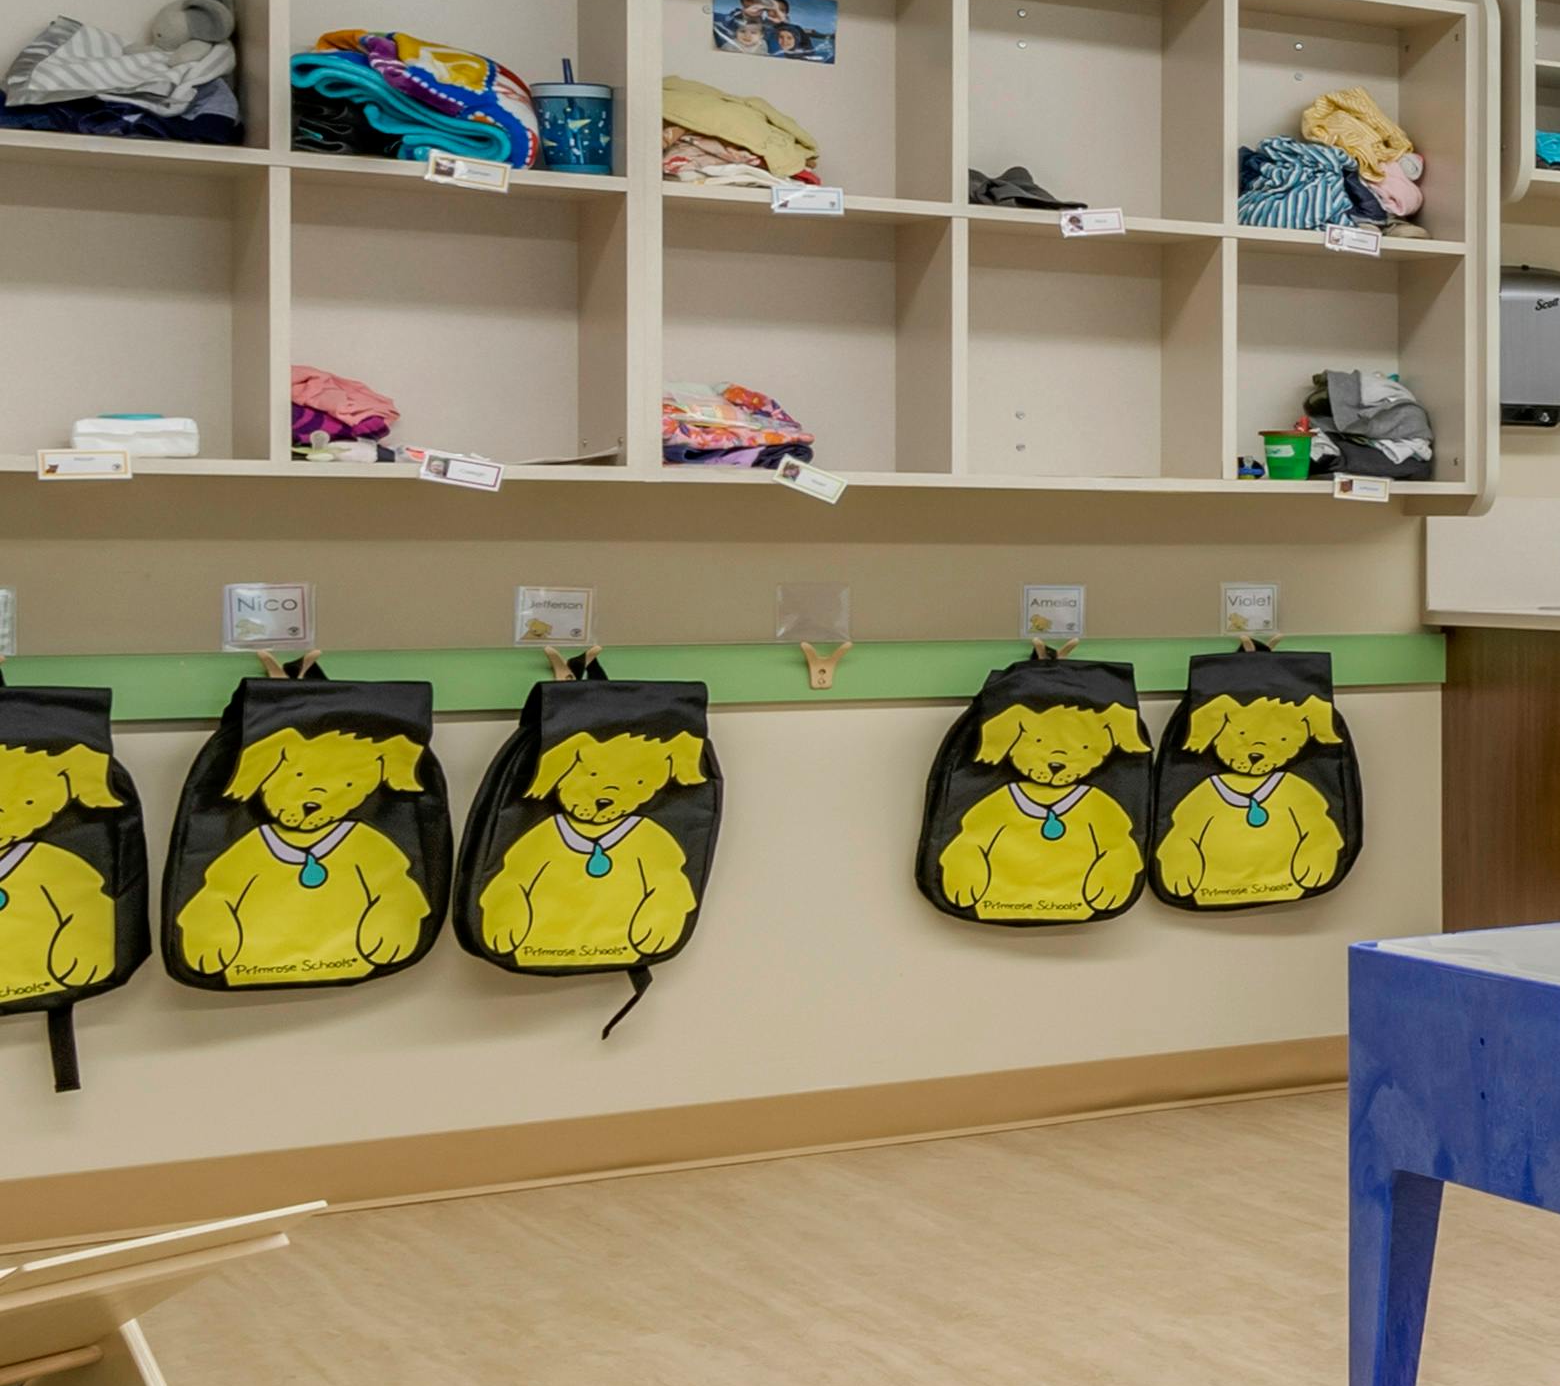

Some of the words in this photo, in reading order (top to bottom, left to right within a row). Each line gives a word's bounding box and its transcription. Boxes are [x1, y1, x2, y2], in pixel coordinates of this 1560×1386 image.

[1535, 298, 1559, 310] Scott
[237, 597, 298, 612] Nico
[529, 598, 583, 610] Jefferson
[1030, 597, 1077, 608] Amelia
[1228, 595, 1272, 607] Violet
[1200, 886, 1248, 897] Primrose
[1250, 883, 1288, 894] Schools
[983, 900, 1033, 910] Primrose
[1036, 899, 1077, 910] Schools
[522, 946, 575, 958] Primrose
[578, 944, 623, 957] Schools
[234, 962, 298, 976] Primrose
[302, 958, 351, 972] Schools
[0, 982, 44, 999] chools
